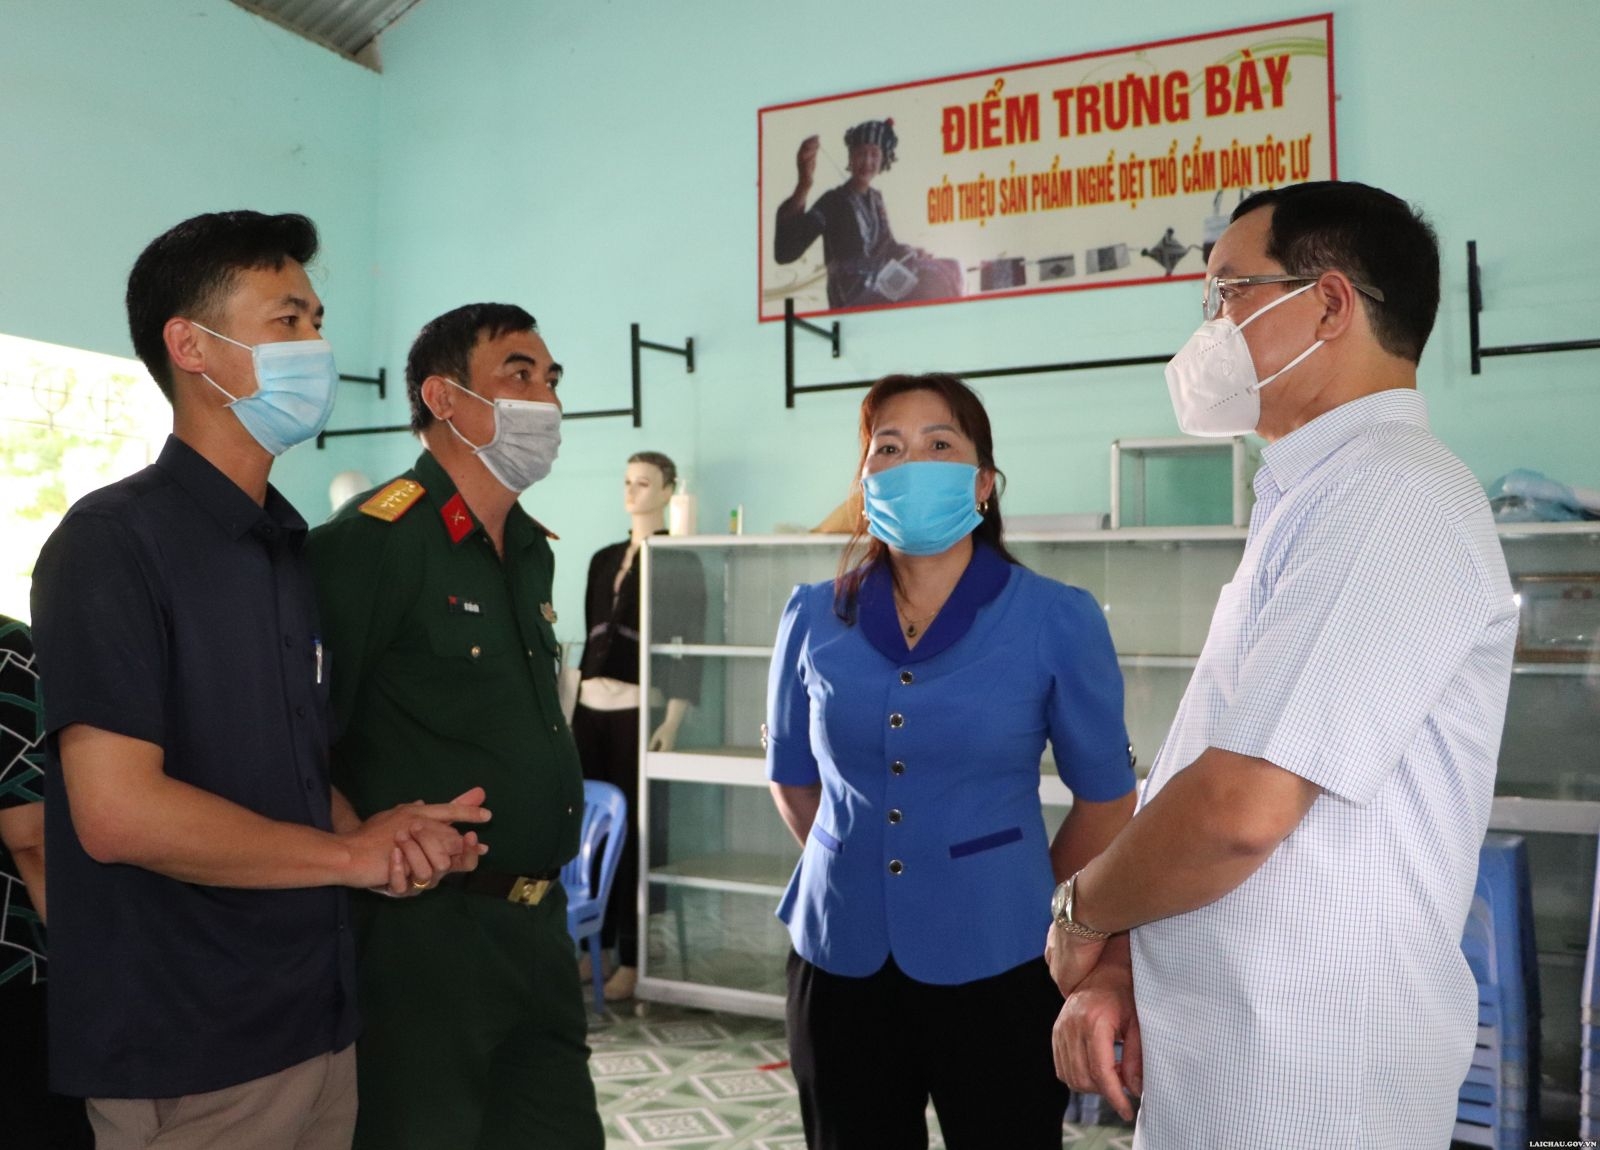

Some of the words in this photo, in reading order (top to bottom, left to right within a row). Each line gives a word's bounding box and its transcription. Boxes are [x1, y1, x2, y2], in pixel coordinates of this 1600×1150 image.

[941, 77, 1040, 154] ĐIỂM
[1052, 71, 1191, 138] TRƯNG
[1204, 48, 1291, 117] BÀY
[927, 174, 954, 225] GIỚI
[957, 171, 996, 228] THIỆU
[999, 159, 1028, 216] SẢN
[1031, 154, 1073, 212] PHẨM
[1119, 152, 1145, 209] DỆT
[1149, 138, 1178, 198] THỔ
[1182, 135, 1216, 194] CẨM
[1220, 138, 1252, 190] DÂN
[1256, 134, 1286, 190] TỘC
